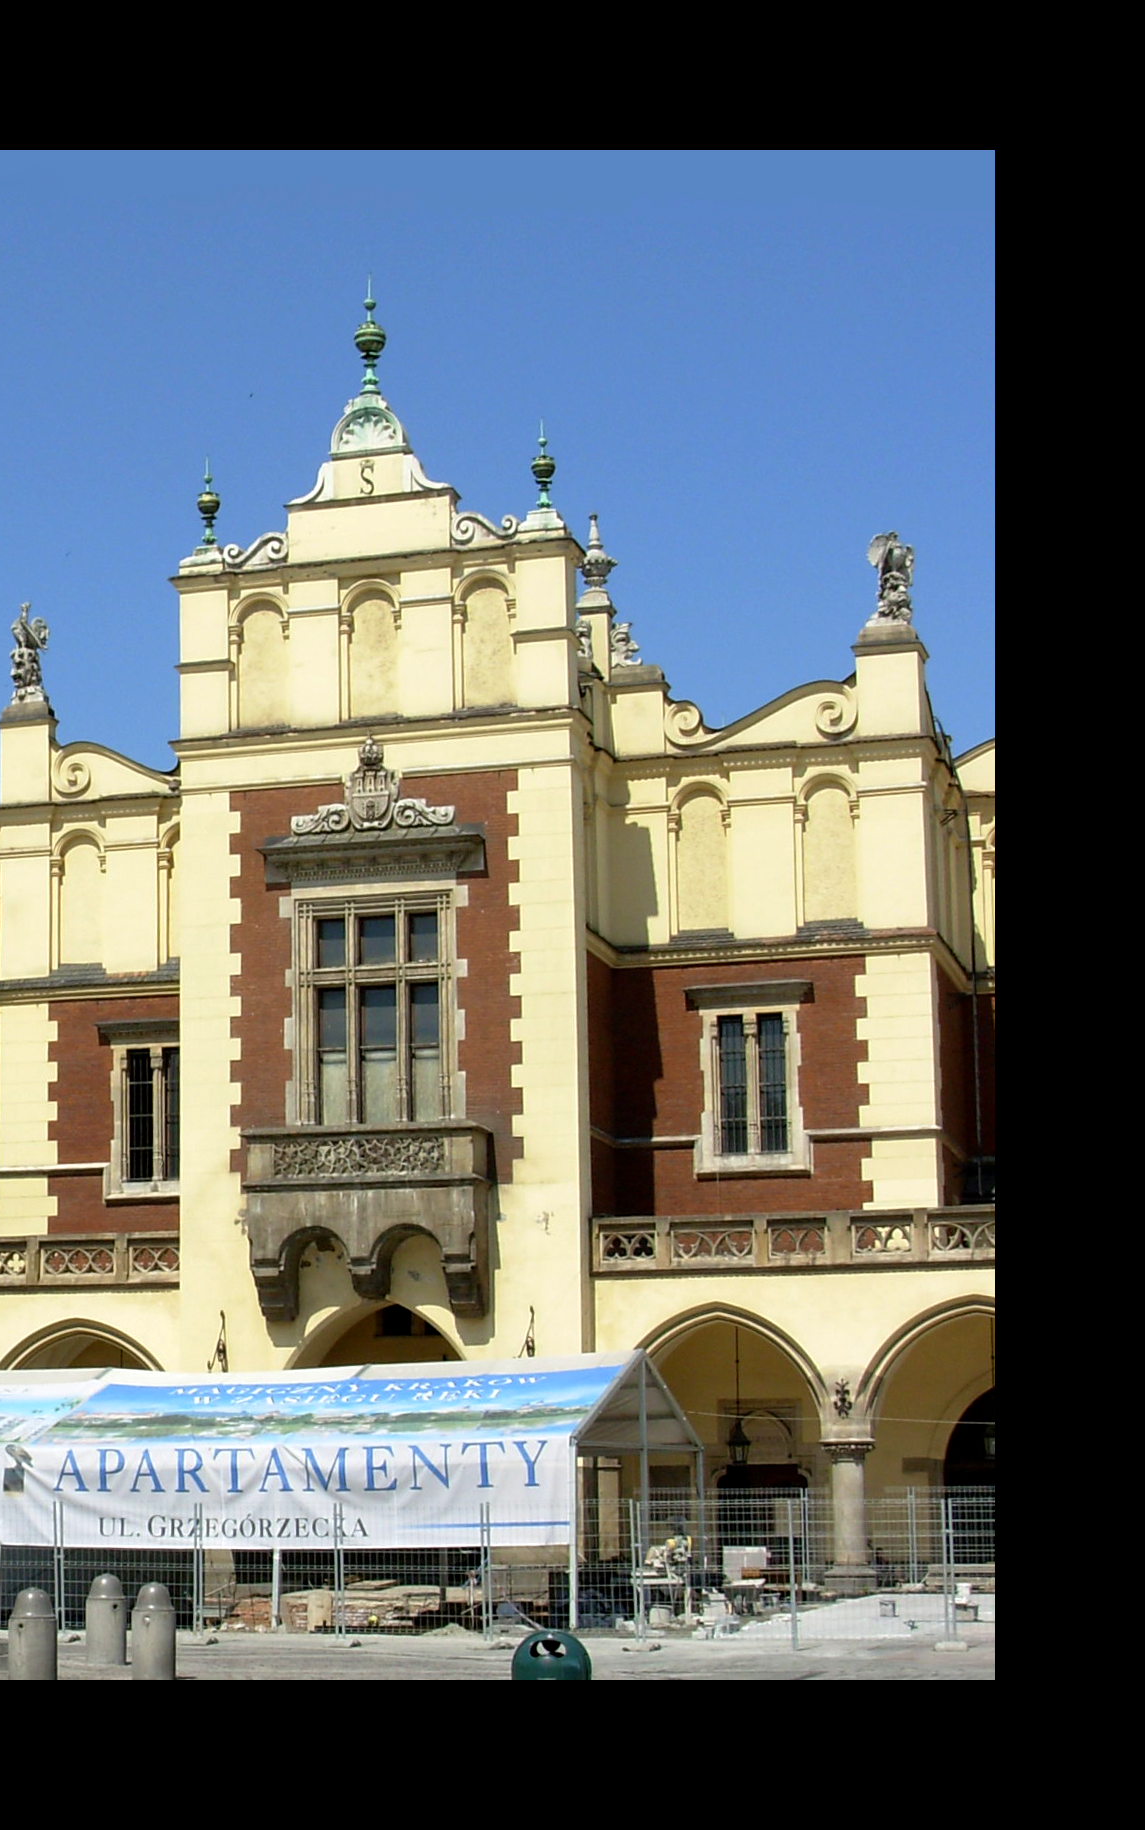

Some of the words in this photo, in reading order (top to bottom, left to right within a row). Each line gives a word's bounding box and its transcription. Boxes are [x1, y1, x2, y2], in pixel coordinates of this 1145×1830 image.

[52, 1440, 549, 1494] APARTAMENTY
[98, 1517, 141, 1538] UL.
[147, 1513, 369, 1539] GRZEGÓRZECKA
